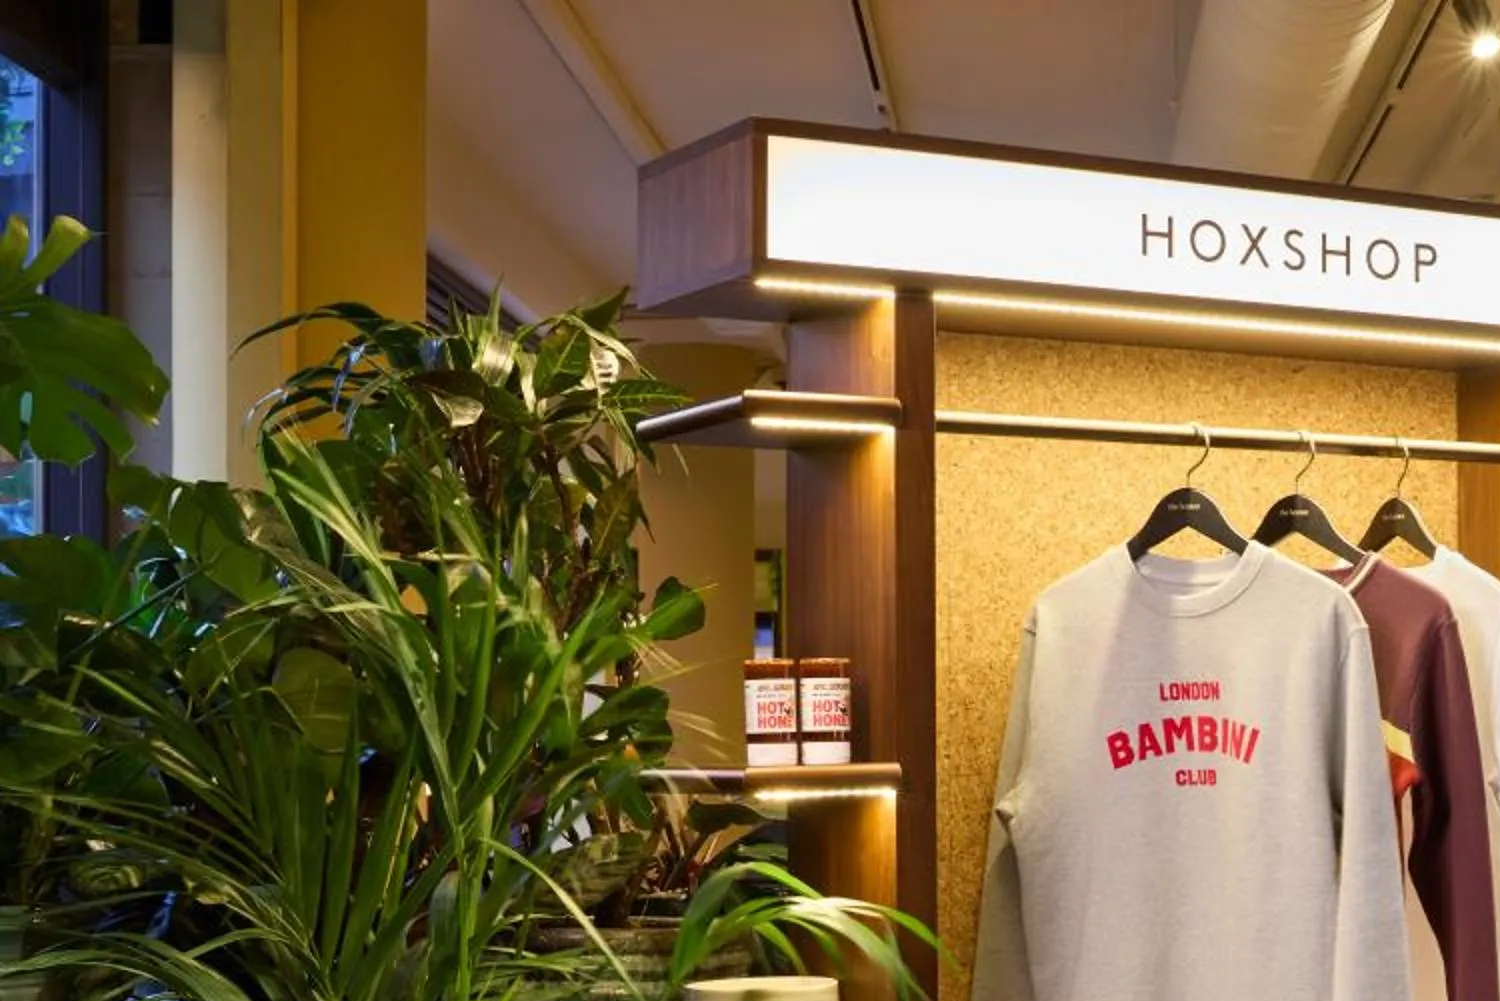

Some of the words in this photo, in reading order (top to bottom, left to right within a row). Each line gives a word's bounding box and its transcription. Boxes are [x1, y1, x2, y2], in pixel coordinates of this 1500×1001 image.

[1141, 212, 1438, 283] HOXSHOP
[1158, 681, 1221, 702] LONDON
[757, 701, 785, 715] HOT
[812, 699, 840, 713] HOT
[1106, 715, 1261, 770] BAMBINI
[1175, 769, 1217, 786] CLUB
